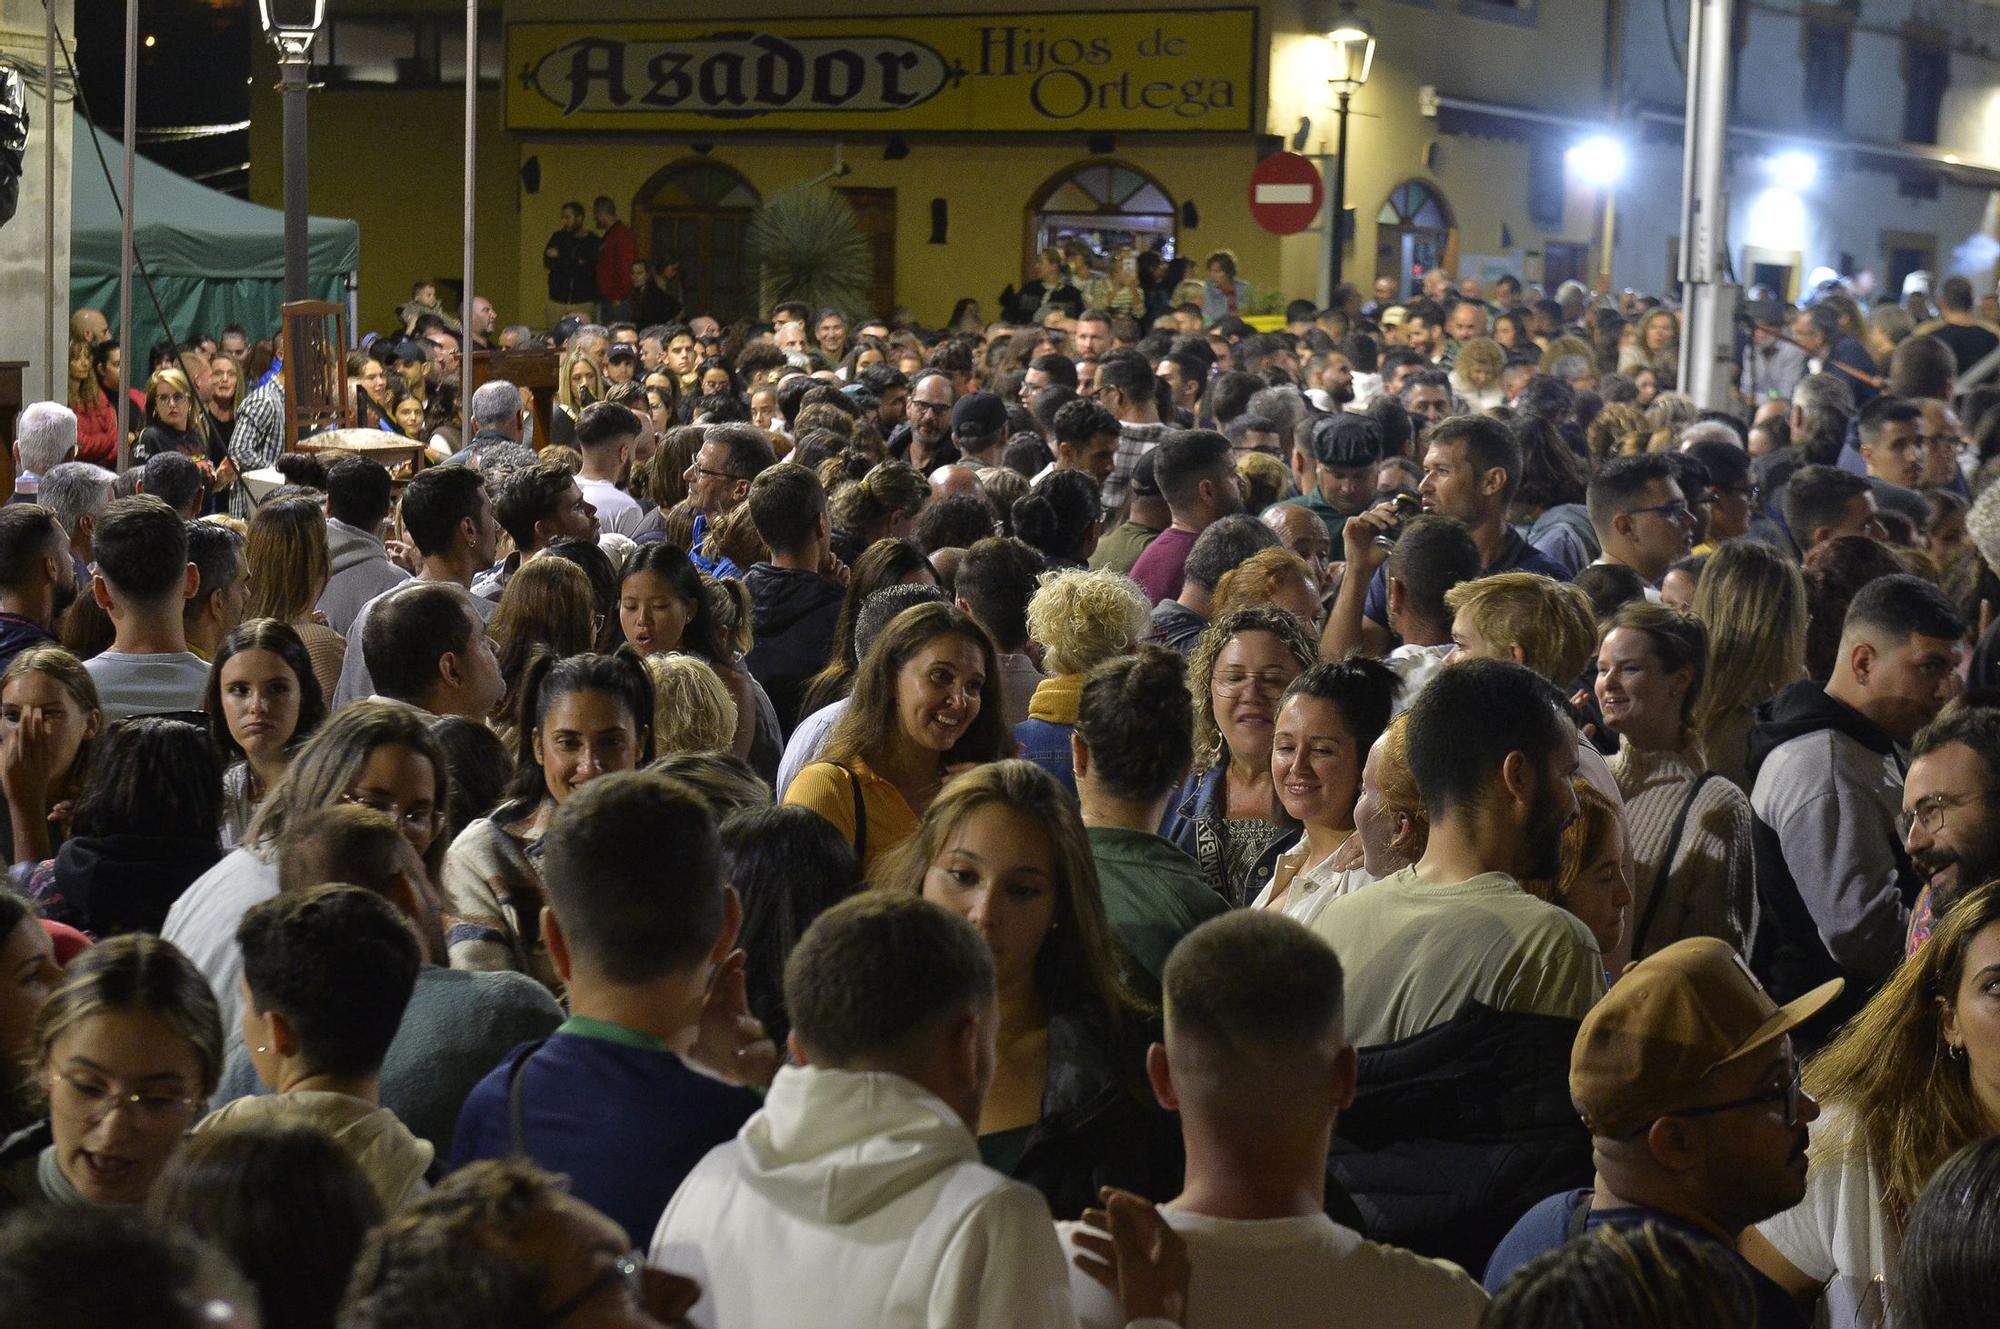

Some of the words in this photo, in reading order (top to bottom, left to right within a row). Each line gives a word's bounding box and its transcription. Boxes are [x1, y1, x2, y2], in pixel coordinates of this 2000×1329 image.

[562, 34, 919, 117] Asador
[974, 26, 1113, 75] Hijos
[1137, 28, 1185, 57] de
[1030, 69, 1235, 119] Ortega
